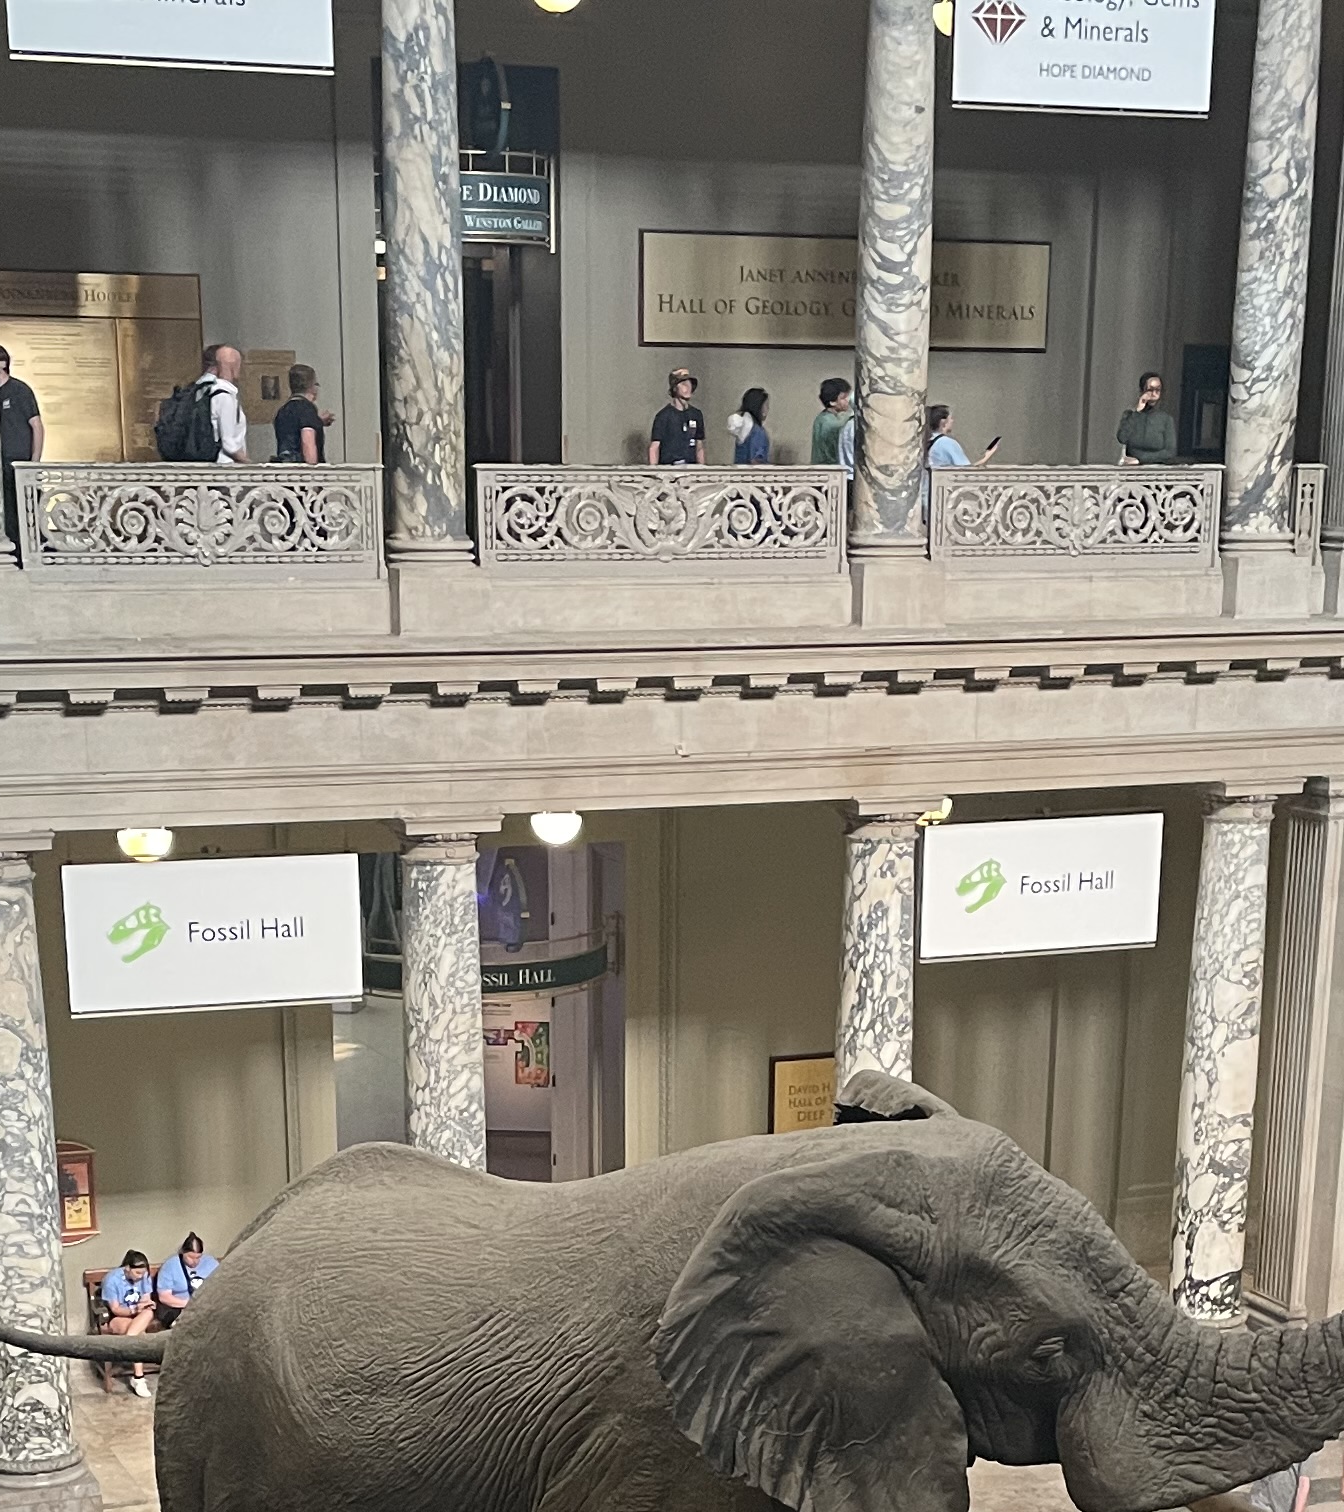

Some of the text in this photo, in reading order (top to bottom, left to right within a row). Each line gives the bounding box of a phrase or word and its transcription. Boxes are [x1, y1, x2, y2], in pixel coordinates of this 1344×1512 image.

[1041, 15, 1149, 43] & Minerals
[1040, 63, 1152, 82] HOPE DIAMOND
[478, 182, 541, 205] DIAMOND
[464, 214, 512, 229] WINSTON
[739, 265, 785, 284] JANET
[658, 294, 706, 315] HALL
[714, 298, 737, 315] OF
[947, 303, 1036, 321] MINERALS
[1020, 870, 1114, 895] Fossil Hall
[188, 915, 305, 944] Fossil Hall
[519, 969, 556, 985] HALL
[789, 1085, 820, 1096] DAVID
[789, 1098, 814, 1109] HALL
[815, 1096, 827, 1106] OF
